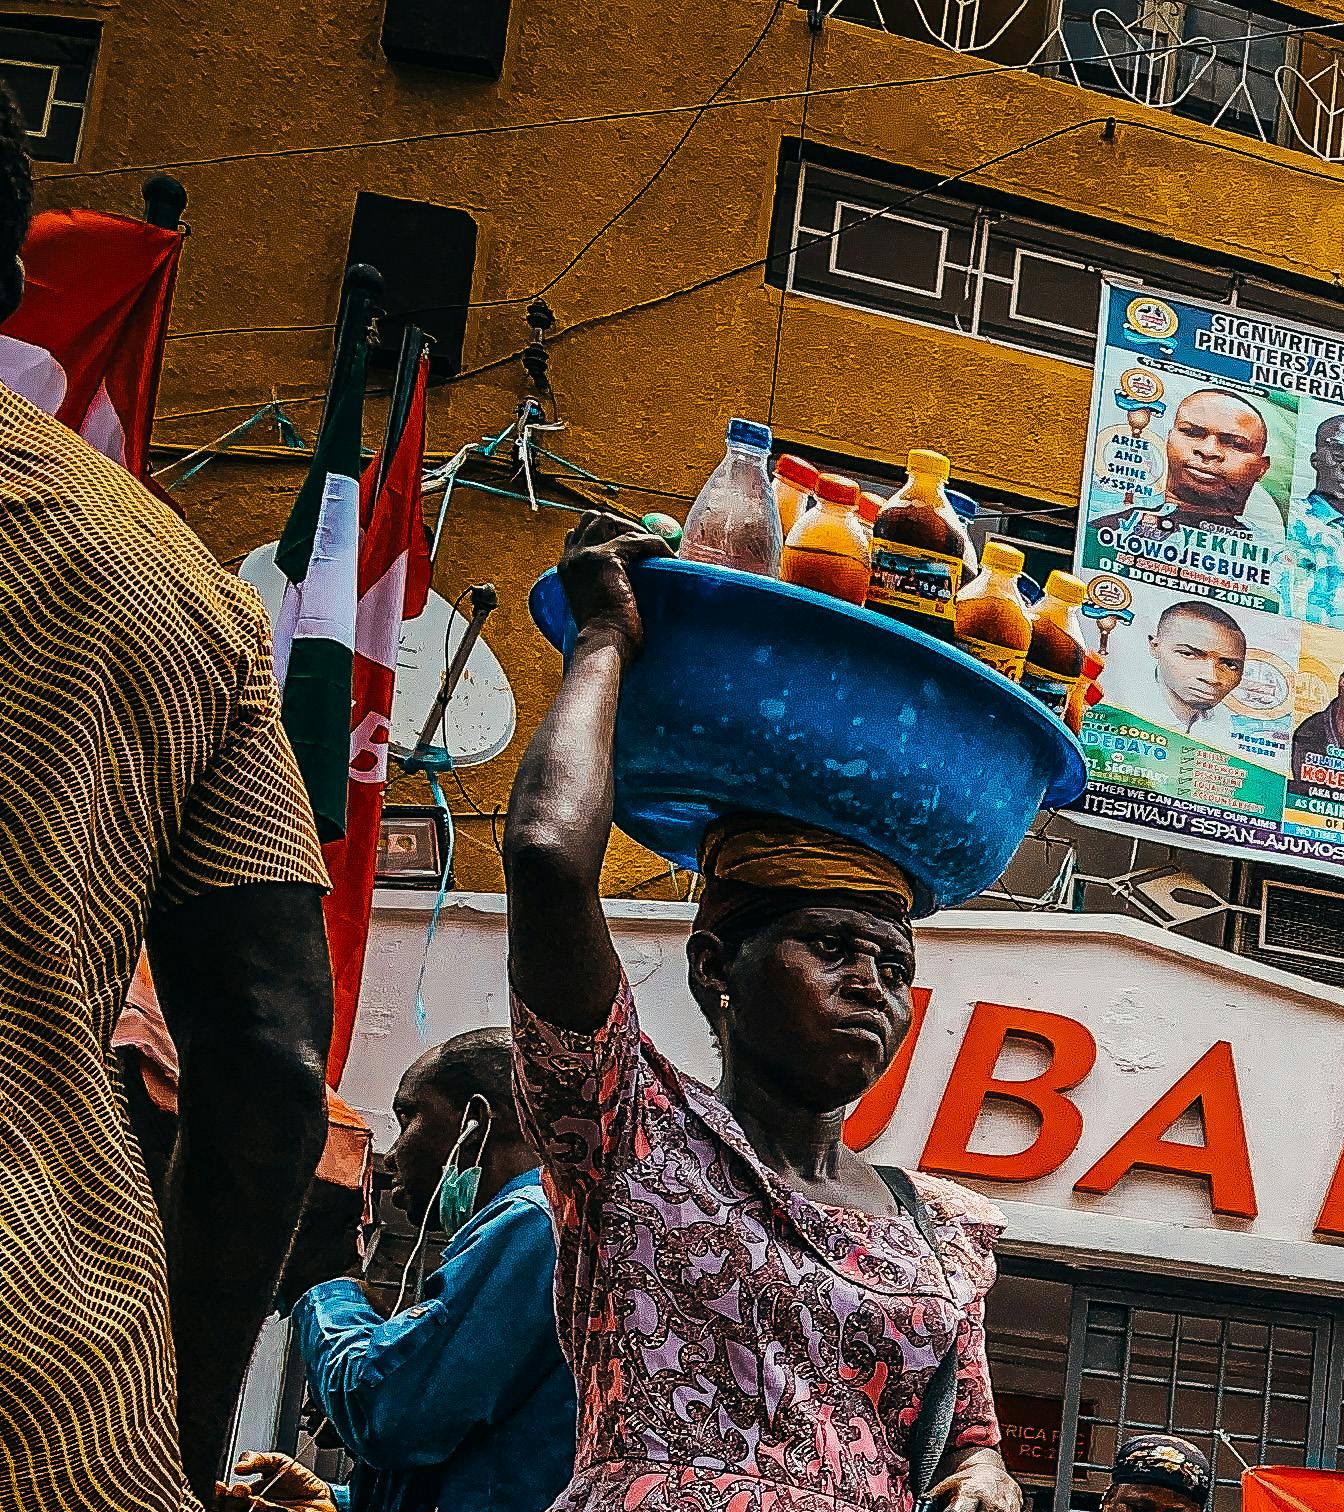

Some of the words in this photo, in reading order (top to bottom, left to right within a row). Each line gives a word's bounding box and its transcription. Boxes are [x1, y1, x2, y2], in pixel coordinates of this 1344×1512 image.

[1195, 328, 1311, 373] PRINTERS
[1111, 434, 1149, 450] ARISE
[1114, 450, 1143, 464] AND
[1108, 463, 1146, 480] SHINE
[1099, 476, 1153, 496] #SSPAN
[1199, 521, 1254, 541] COMRADE
[1180, 527, 1270, 565] YEKINI
[1098, 527, 1271, 586] OLOWOJEGBURE
[1100, 558, 1128, 575] OF
[1129, 567, 1211, 596] DOCEMU
[1216, 588, 1266, 609] ZONE
[1084, 795, 1187, 829] ITESIWAJU
[1087, 781, 1126, 797] ETHER
[1127, 789, 1145, 800] WE
[1148, 793, 1172, 806] CAN
[1173, 799, 1222, 819] ACHIEVE
[1222, 811, 1248, 824] OUR
[1248, 817, 1277, 830] AIMS
[1296, 826, 1311, 837] NO
[1325, 819, 1339, 829] OF
